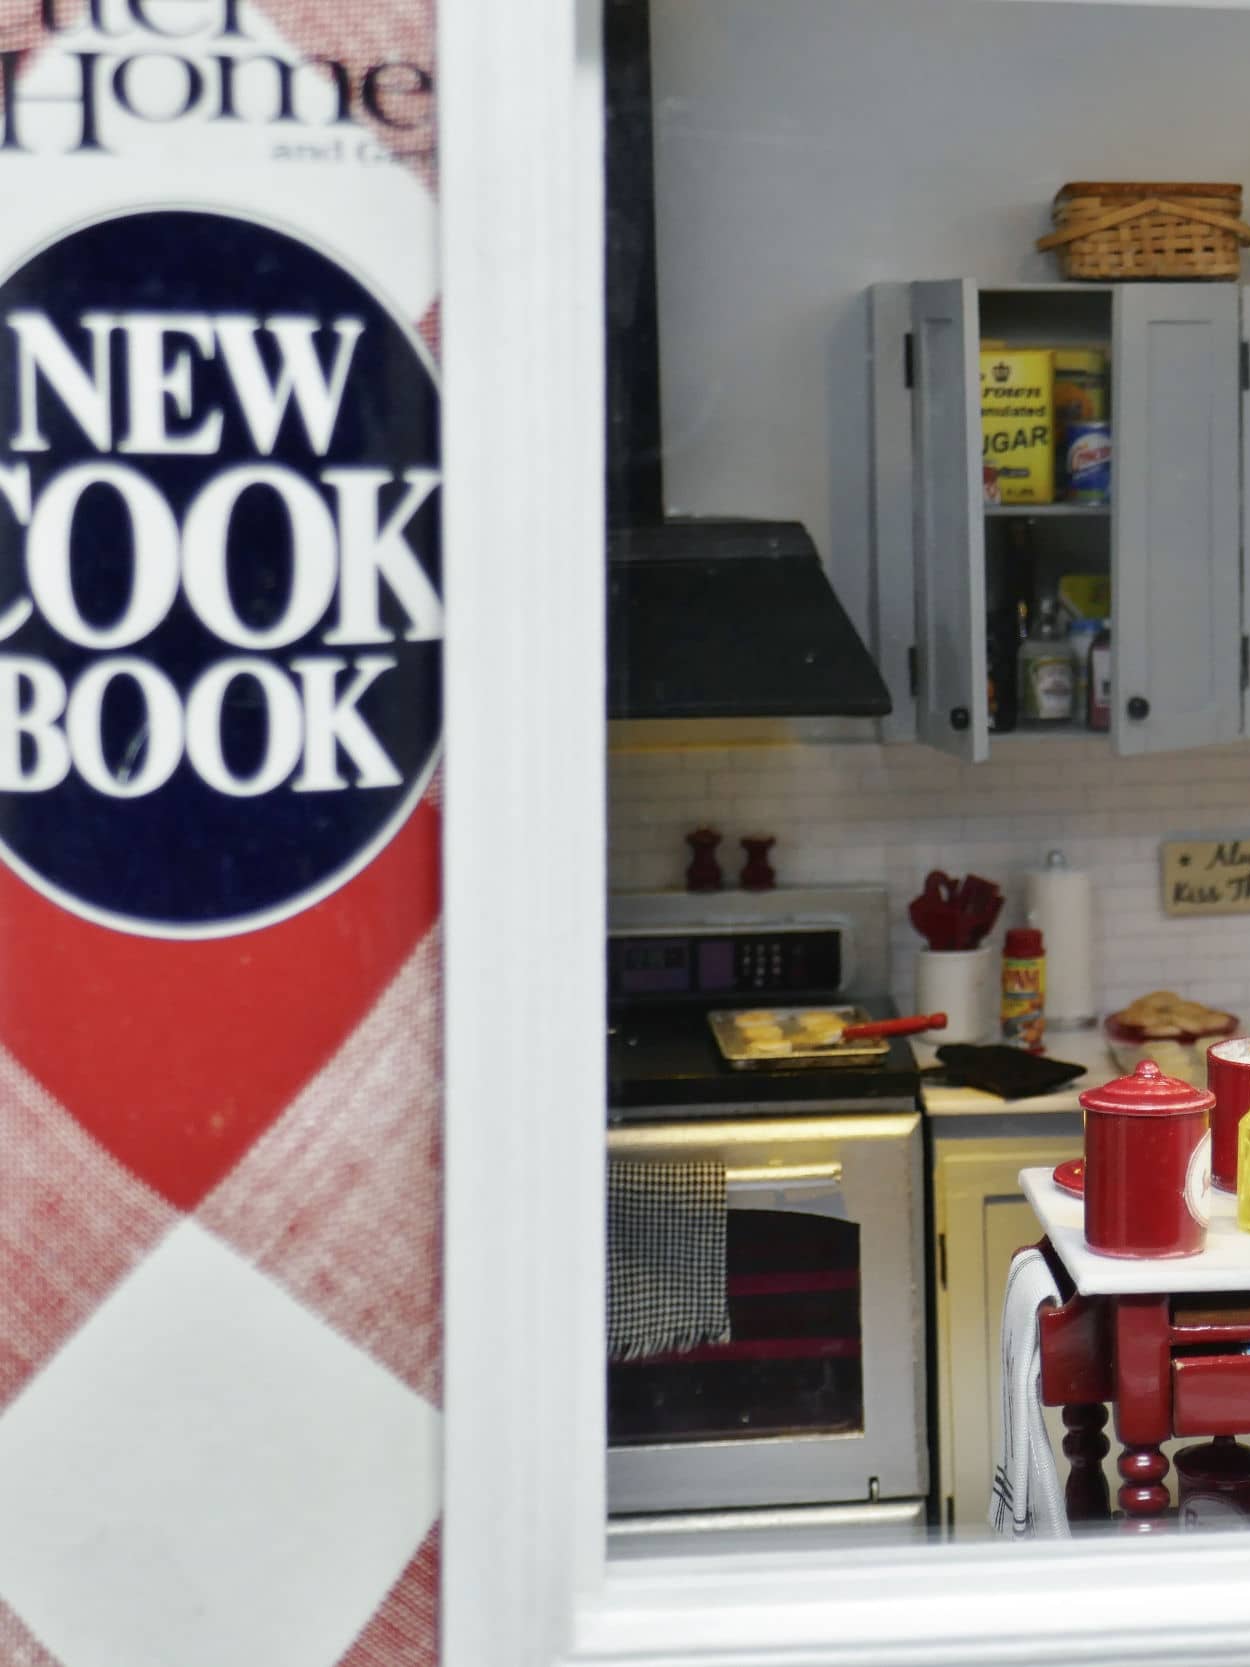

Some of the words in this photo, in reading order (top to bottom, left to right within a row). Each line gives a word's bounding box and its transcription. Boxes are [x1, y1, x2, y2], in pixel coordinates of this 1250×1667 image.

[0, 50, 434, 153] Home
[271, 139, 344, 163] and
[6, 311, 366, 457] NEW
[0, 461, 442, 651] OOK
[0, 656, 404, 799] BOOK
[1173, 881, 1220, 905] Kiss
